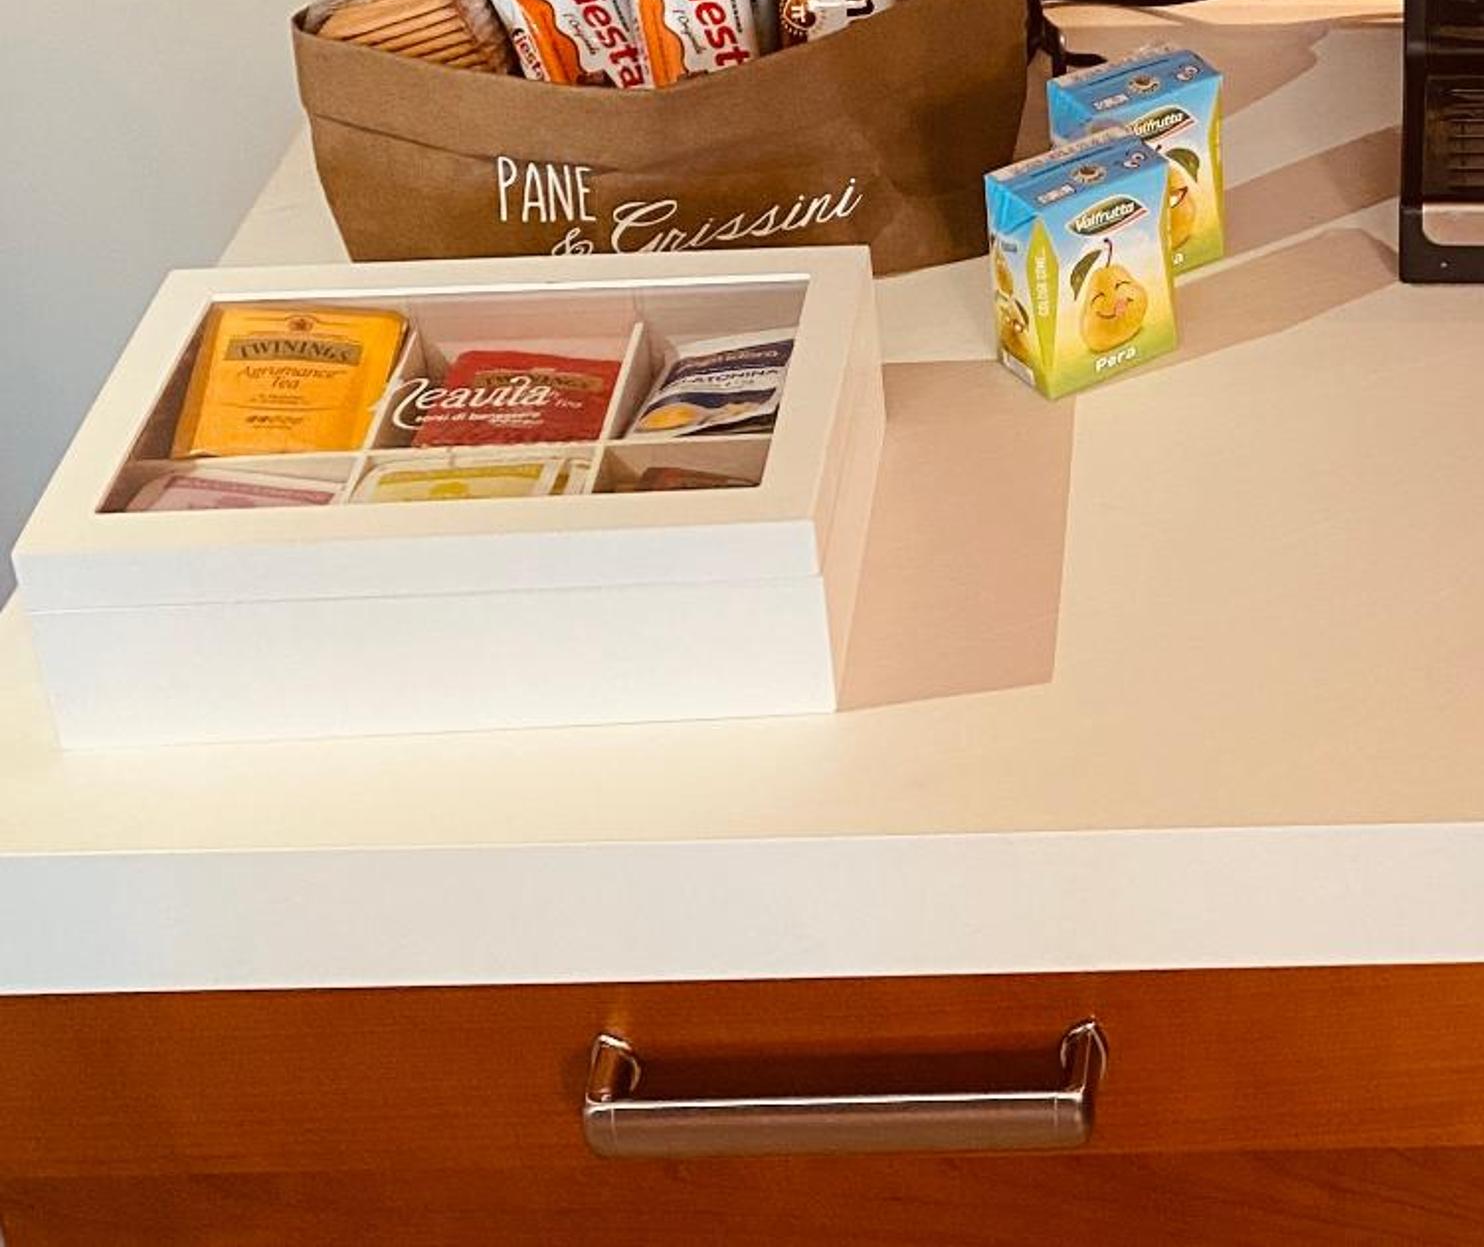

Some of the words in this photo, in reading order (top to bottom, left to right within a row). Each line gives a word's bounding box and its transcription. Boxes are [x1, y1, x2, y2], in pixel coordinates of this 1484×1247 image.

[1132, 112, 1184, 137] alfrutta
[497, 155, 598, 223] PANE
[611, 177, 863, 254] Grissini
[1074, 201, 1137, 233] Valfrutta
[239, 339, 352, 363] TWININGS
[1094, 347, 1137, 373] Pera
